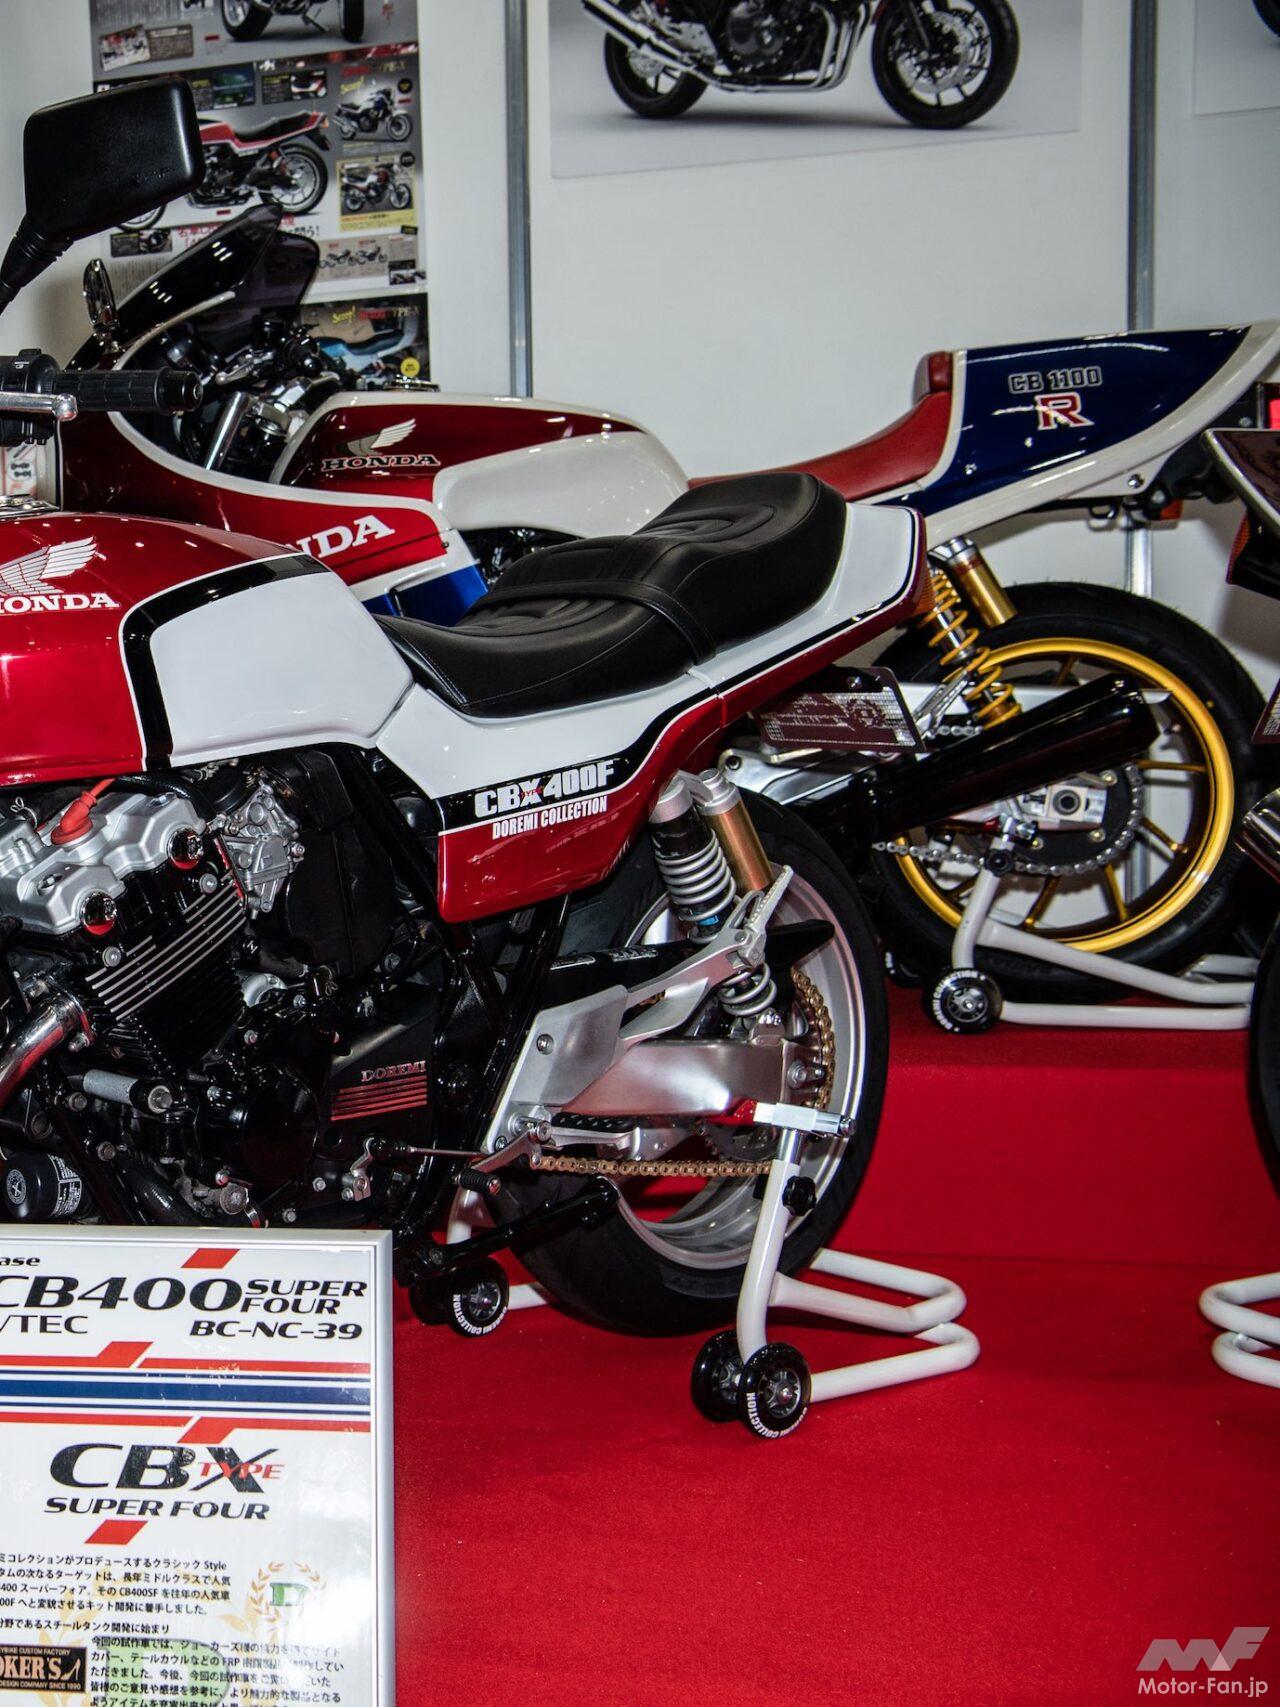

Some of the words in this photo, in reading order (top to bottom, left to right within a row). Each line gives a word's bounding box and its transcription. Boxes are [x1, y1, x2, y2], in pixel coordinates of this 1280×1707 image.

[1008, 372, 1044, 394] CB
[1046, 366, 1103, 390] 1100
[1034, 392, 1095, 431] R
[320, 454, 441, 472] HONDA
[492, 812, 539, 840] DOREMI
[540, 796, 608, 828] COLLECTION
[361, 1060, 426, 1082] DOREMI
[245, 1279, 368, 1297] SUPER
[240, 1298, 341, 1314] FOUR
[190, 1320, 363, 1340] BC-NC-39
[746, 1392, 780, 1439] COLLECTION
[50, 1442, 280, 1493] CBX
[198, 1461, 285, 1480] TYPE
[44, 1497, 164, 1517] SUPER
[170, 1500, 271, 1520] FOUR
[204, 1559, 227, 1572] Style
[19, 1647, 42, 1656] CUSTOM
[43, 1648, 71, 1657] FACTORY
